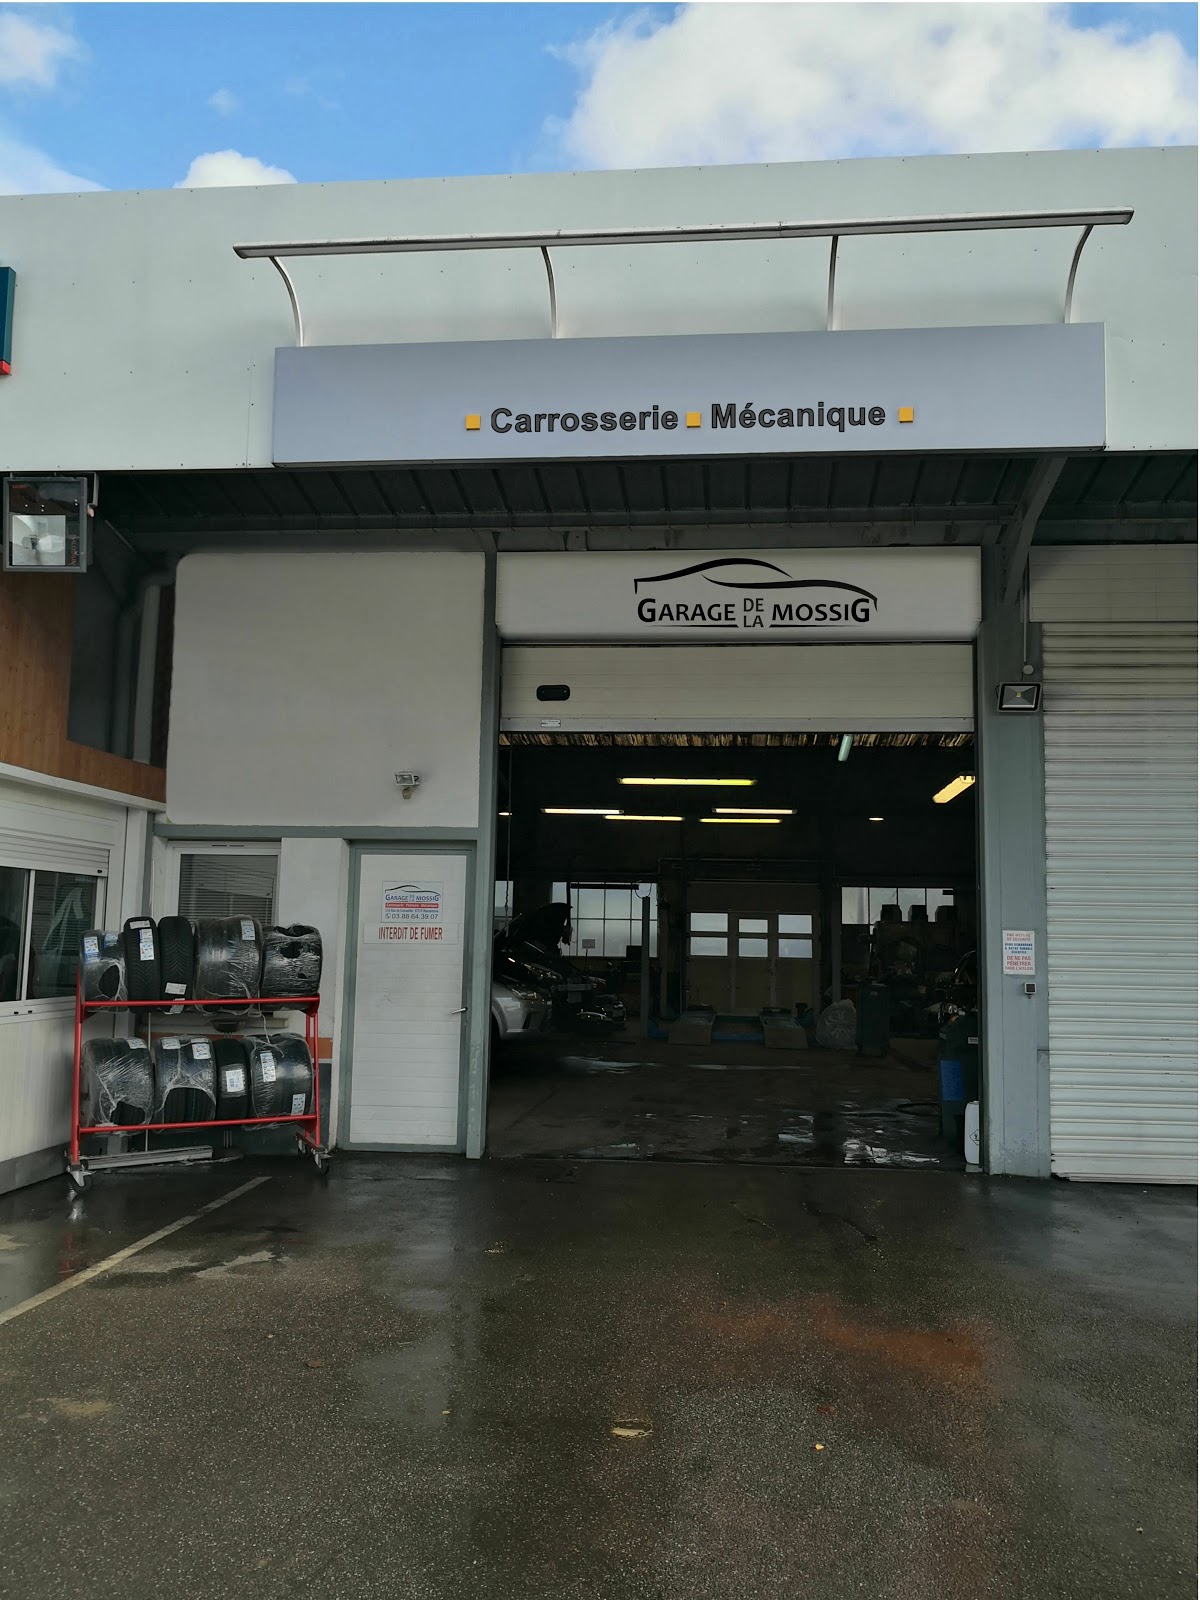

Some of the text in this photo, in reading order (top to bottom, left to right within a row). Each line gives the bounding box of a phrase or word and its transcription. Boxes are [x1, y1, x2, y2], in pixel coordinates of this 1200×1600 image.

[491, 401, 887, 434] Carrosserie Mécanique
[637, 597, 870, 628] GARAGE DE LA MOSSIG
[379, 927, 442, 940] INTERDIT DE FUMER
